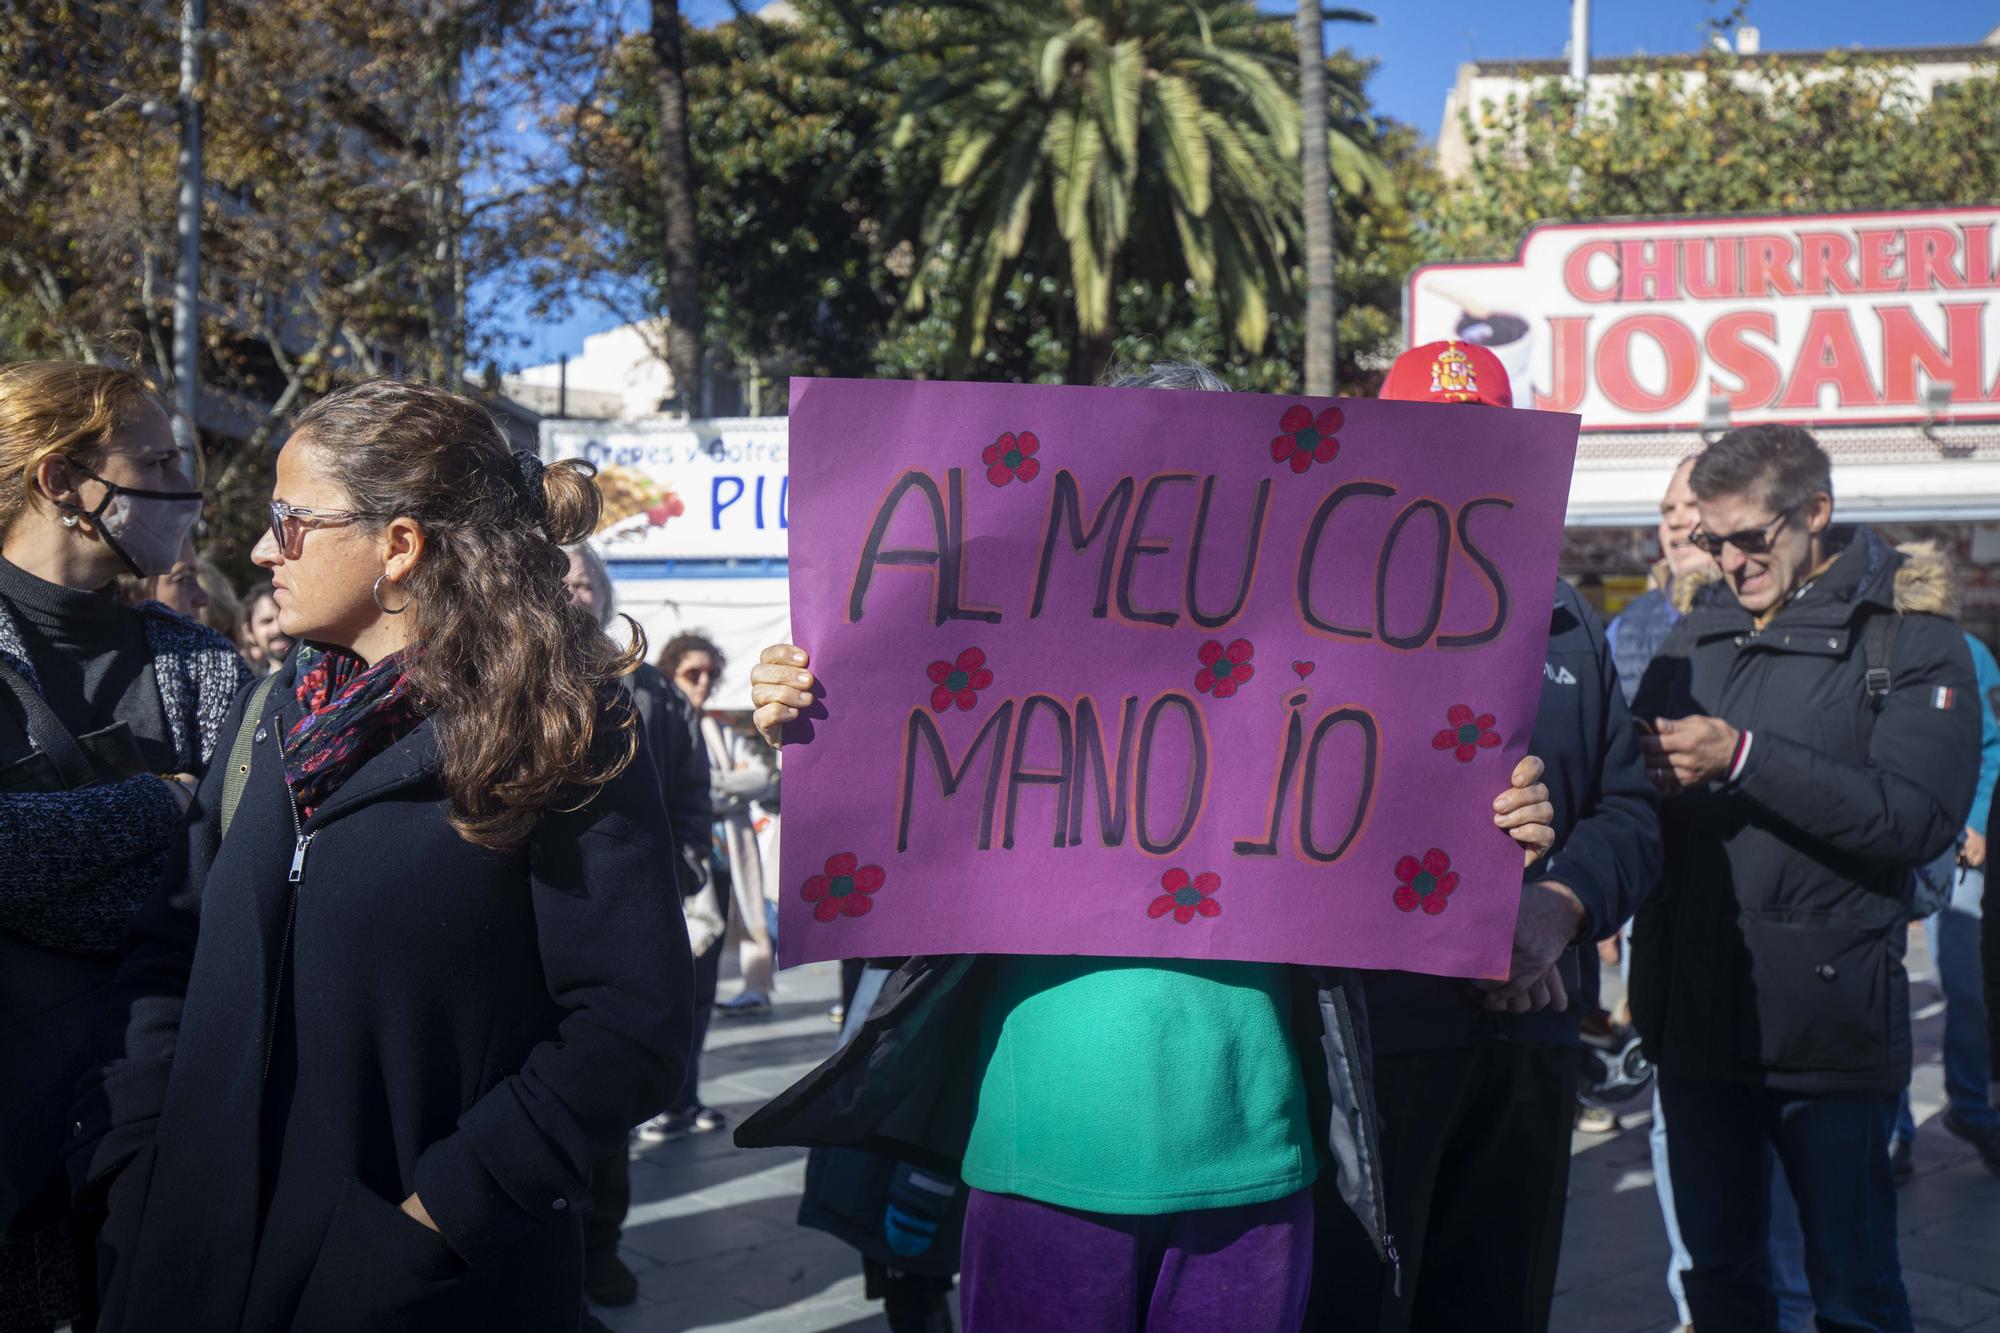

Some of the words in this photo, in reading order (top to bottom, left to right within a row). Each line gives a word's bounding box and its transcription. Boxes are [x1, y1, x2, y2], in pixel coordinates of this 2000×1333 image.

[1563, 223, 2000, 303] CHURRERI
[1531, 302, 2000, 413] JOSAN
[708, 437, 789, 464] Gofre
[848, 466, 1002, 627] AL
[1028, 469, 1272, 628] MEU
[1299, 481, 1514, 649] COS
[1544, 661, 1577, 685] ILA
[897, 688, 1214, 856] MANO
